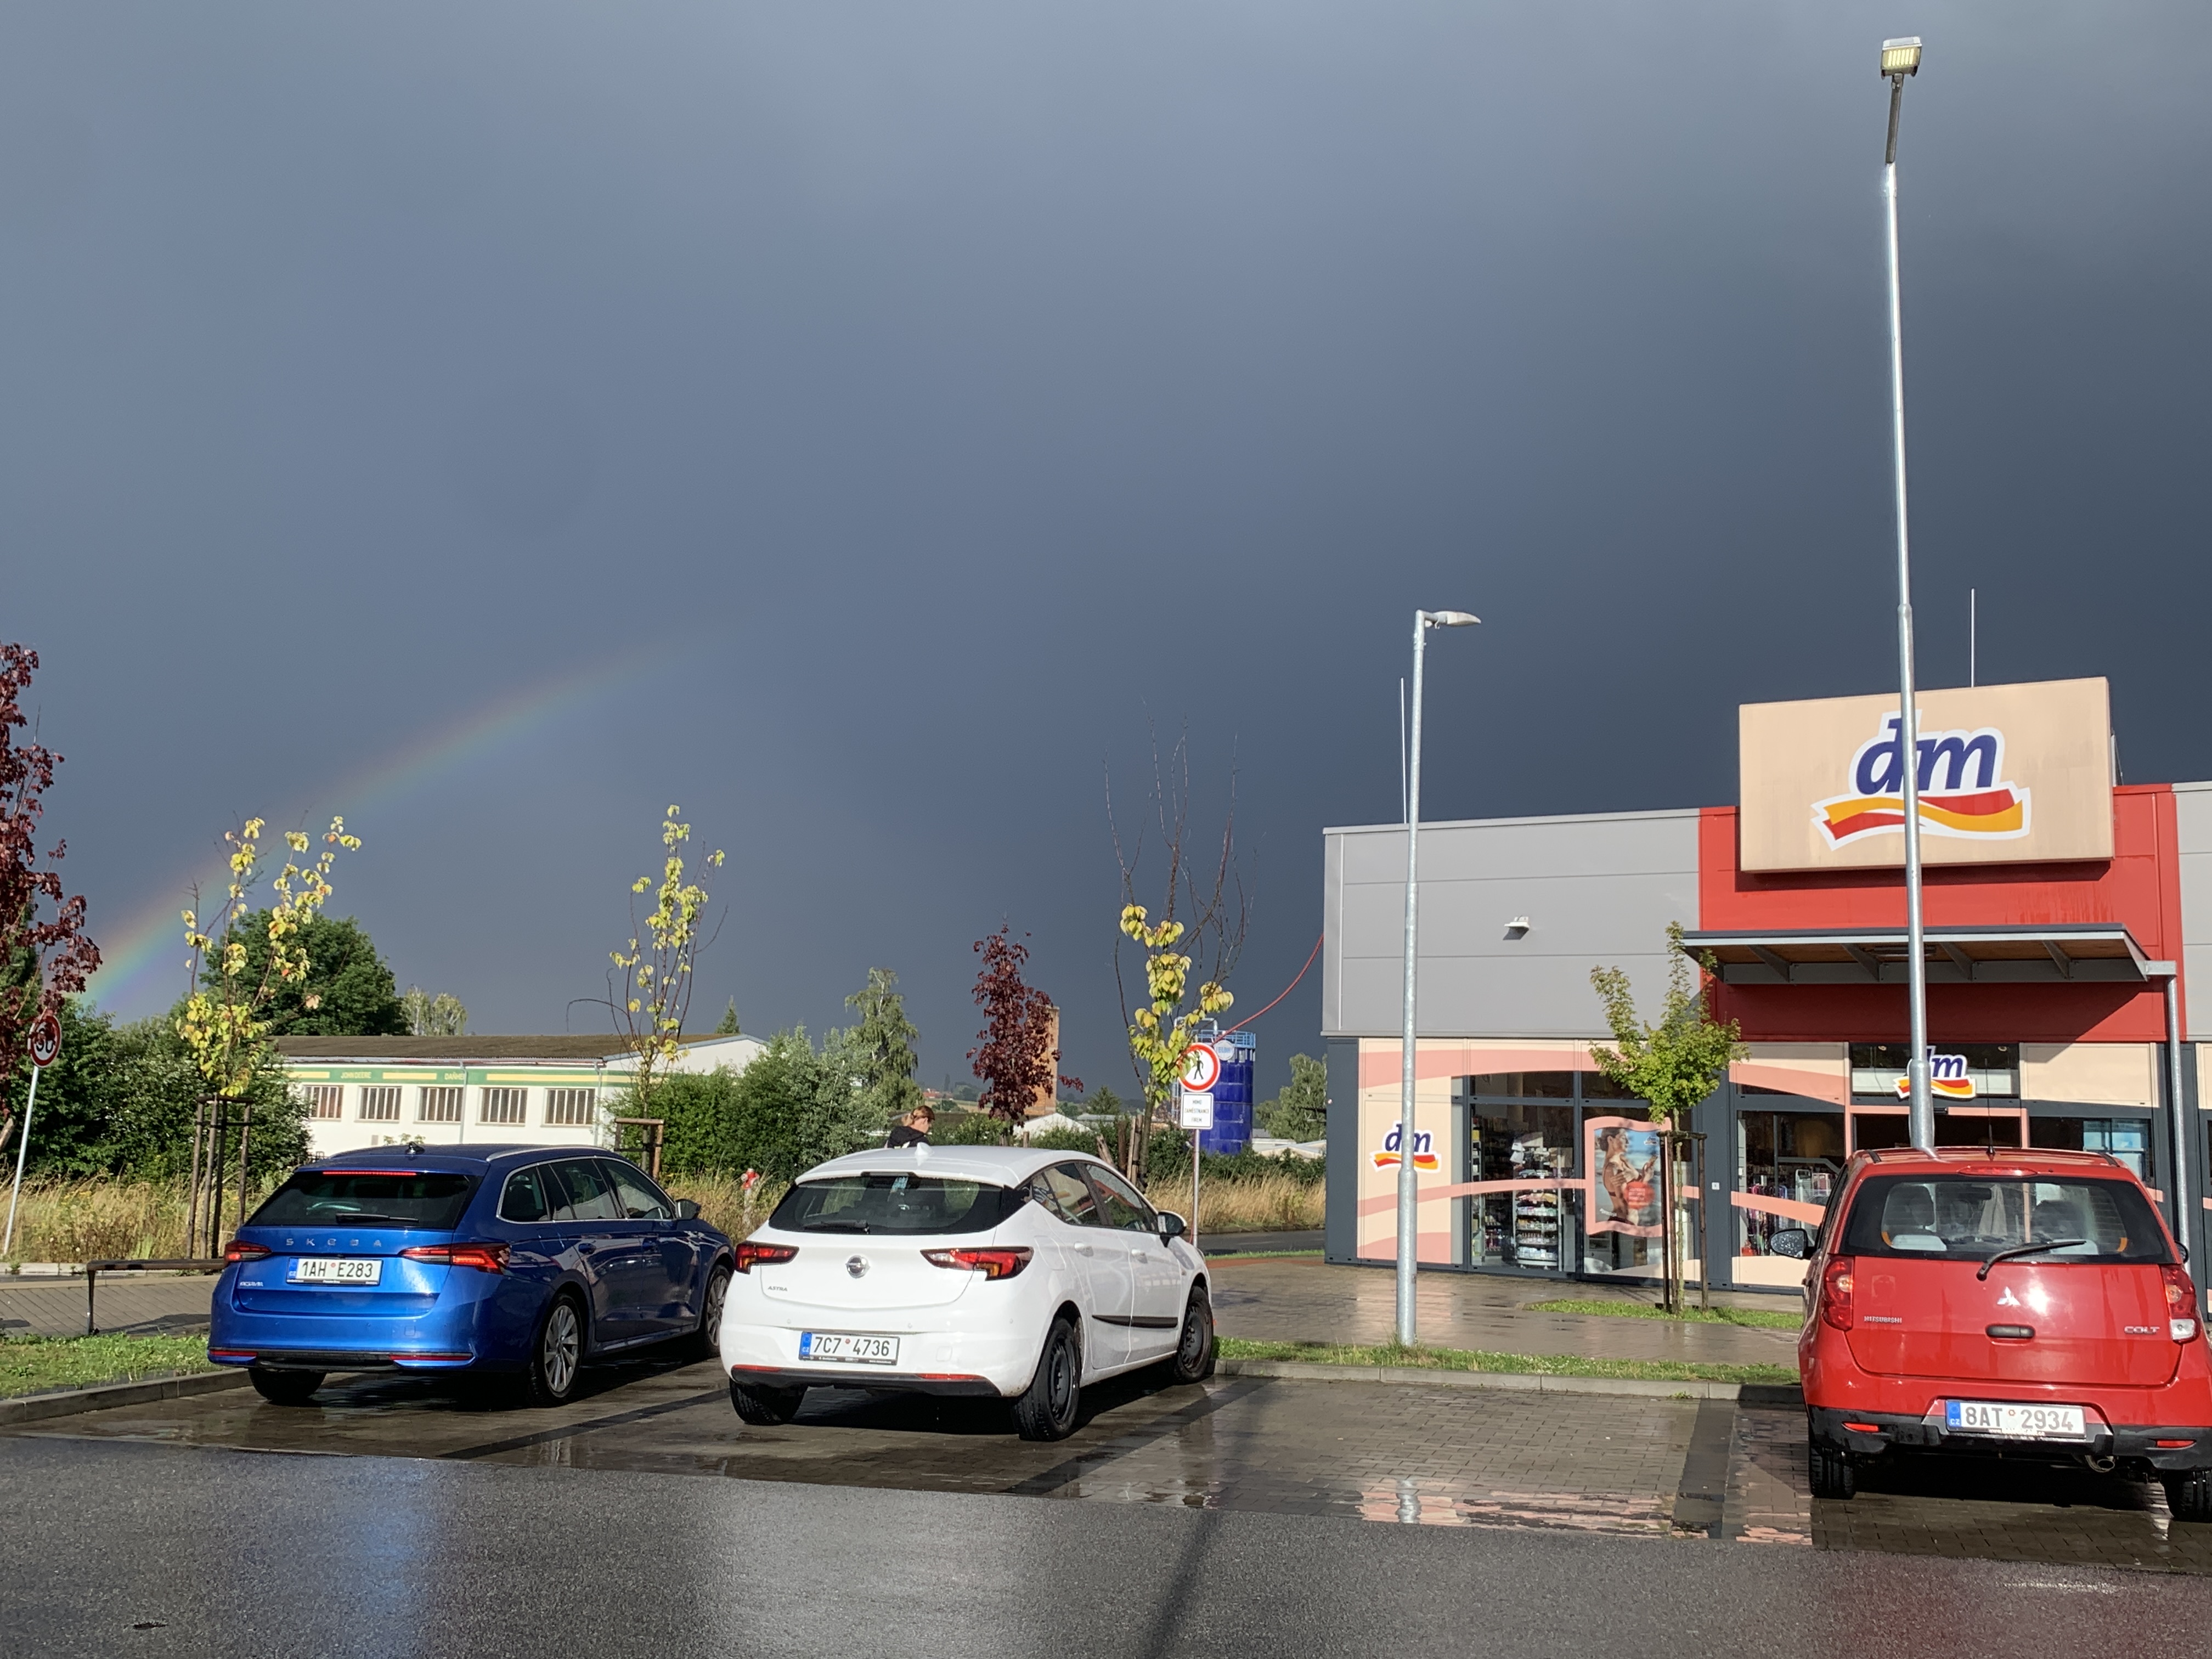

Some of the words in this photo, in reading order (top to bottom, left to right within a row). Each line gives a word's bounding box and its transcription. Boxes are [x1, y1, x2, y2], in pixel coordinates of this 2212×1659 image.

[1856, 718, 1997, 795] dm
[1385, 1124, 1431, 1153] dm
[302, 1261, 327, 1277] 1AH
[337, 1262, 373, 1277] E283
[1864, 1316, 1903, 1324] MITSUBISHI
[2124, 1326, 2160, 1334] COLT
[814, 1336, 842, 1353] 7C7
[853, 1339, 890, 1356] 4736
[1965, 1406, 2002, 1427] 8AT
[2021, 1409, 2074, 1431] 2934
